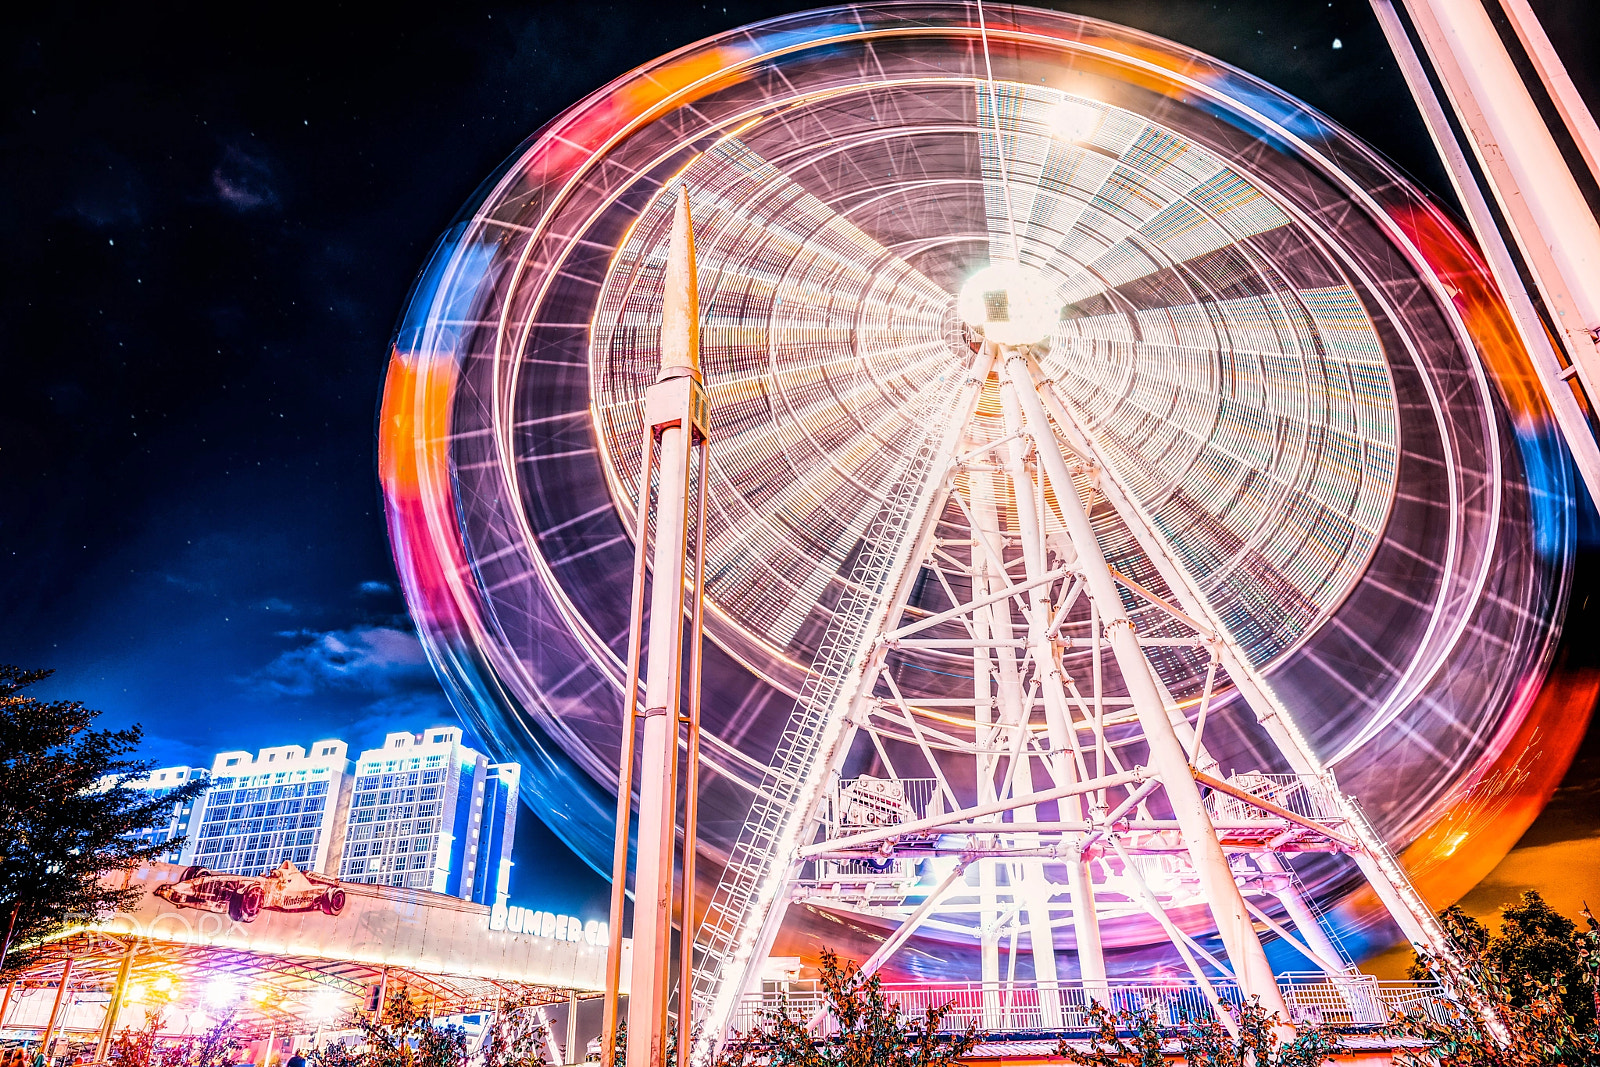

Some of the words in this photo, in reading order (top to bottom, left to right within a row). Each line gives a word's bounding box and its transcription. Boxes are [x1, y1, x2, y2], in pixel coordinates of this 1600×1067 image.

[283, 895, 313, 906] Windspeed
[490, 903, 582, 942] BUMPER
[585, 920, 609, 947] CA
